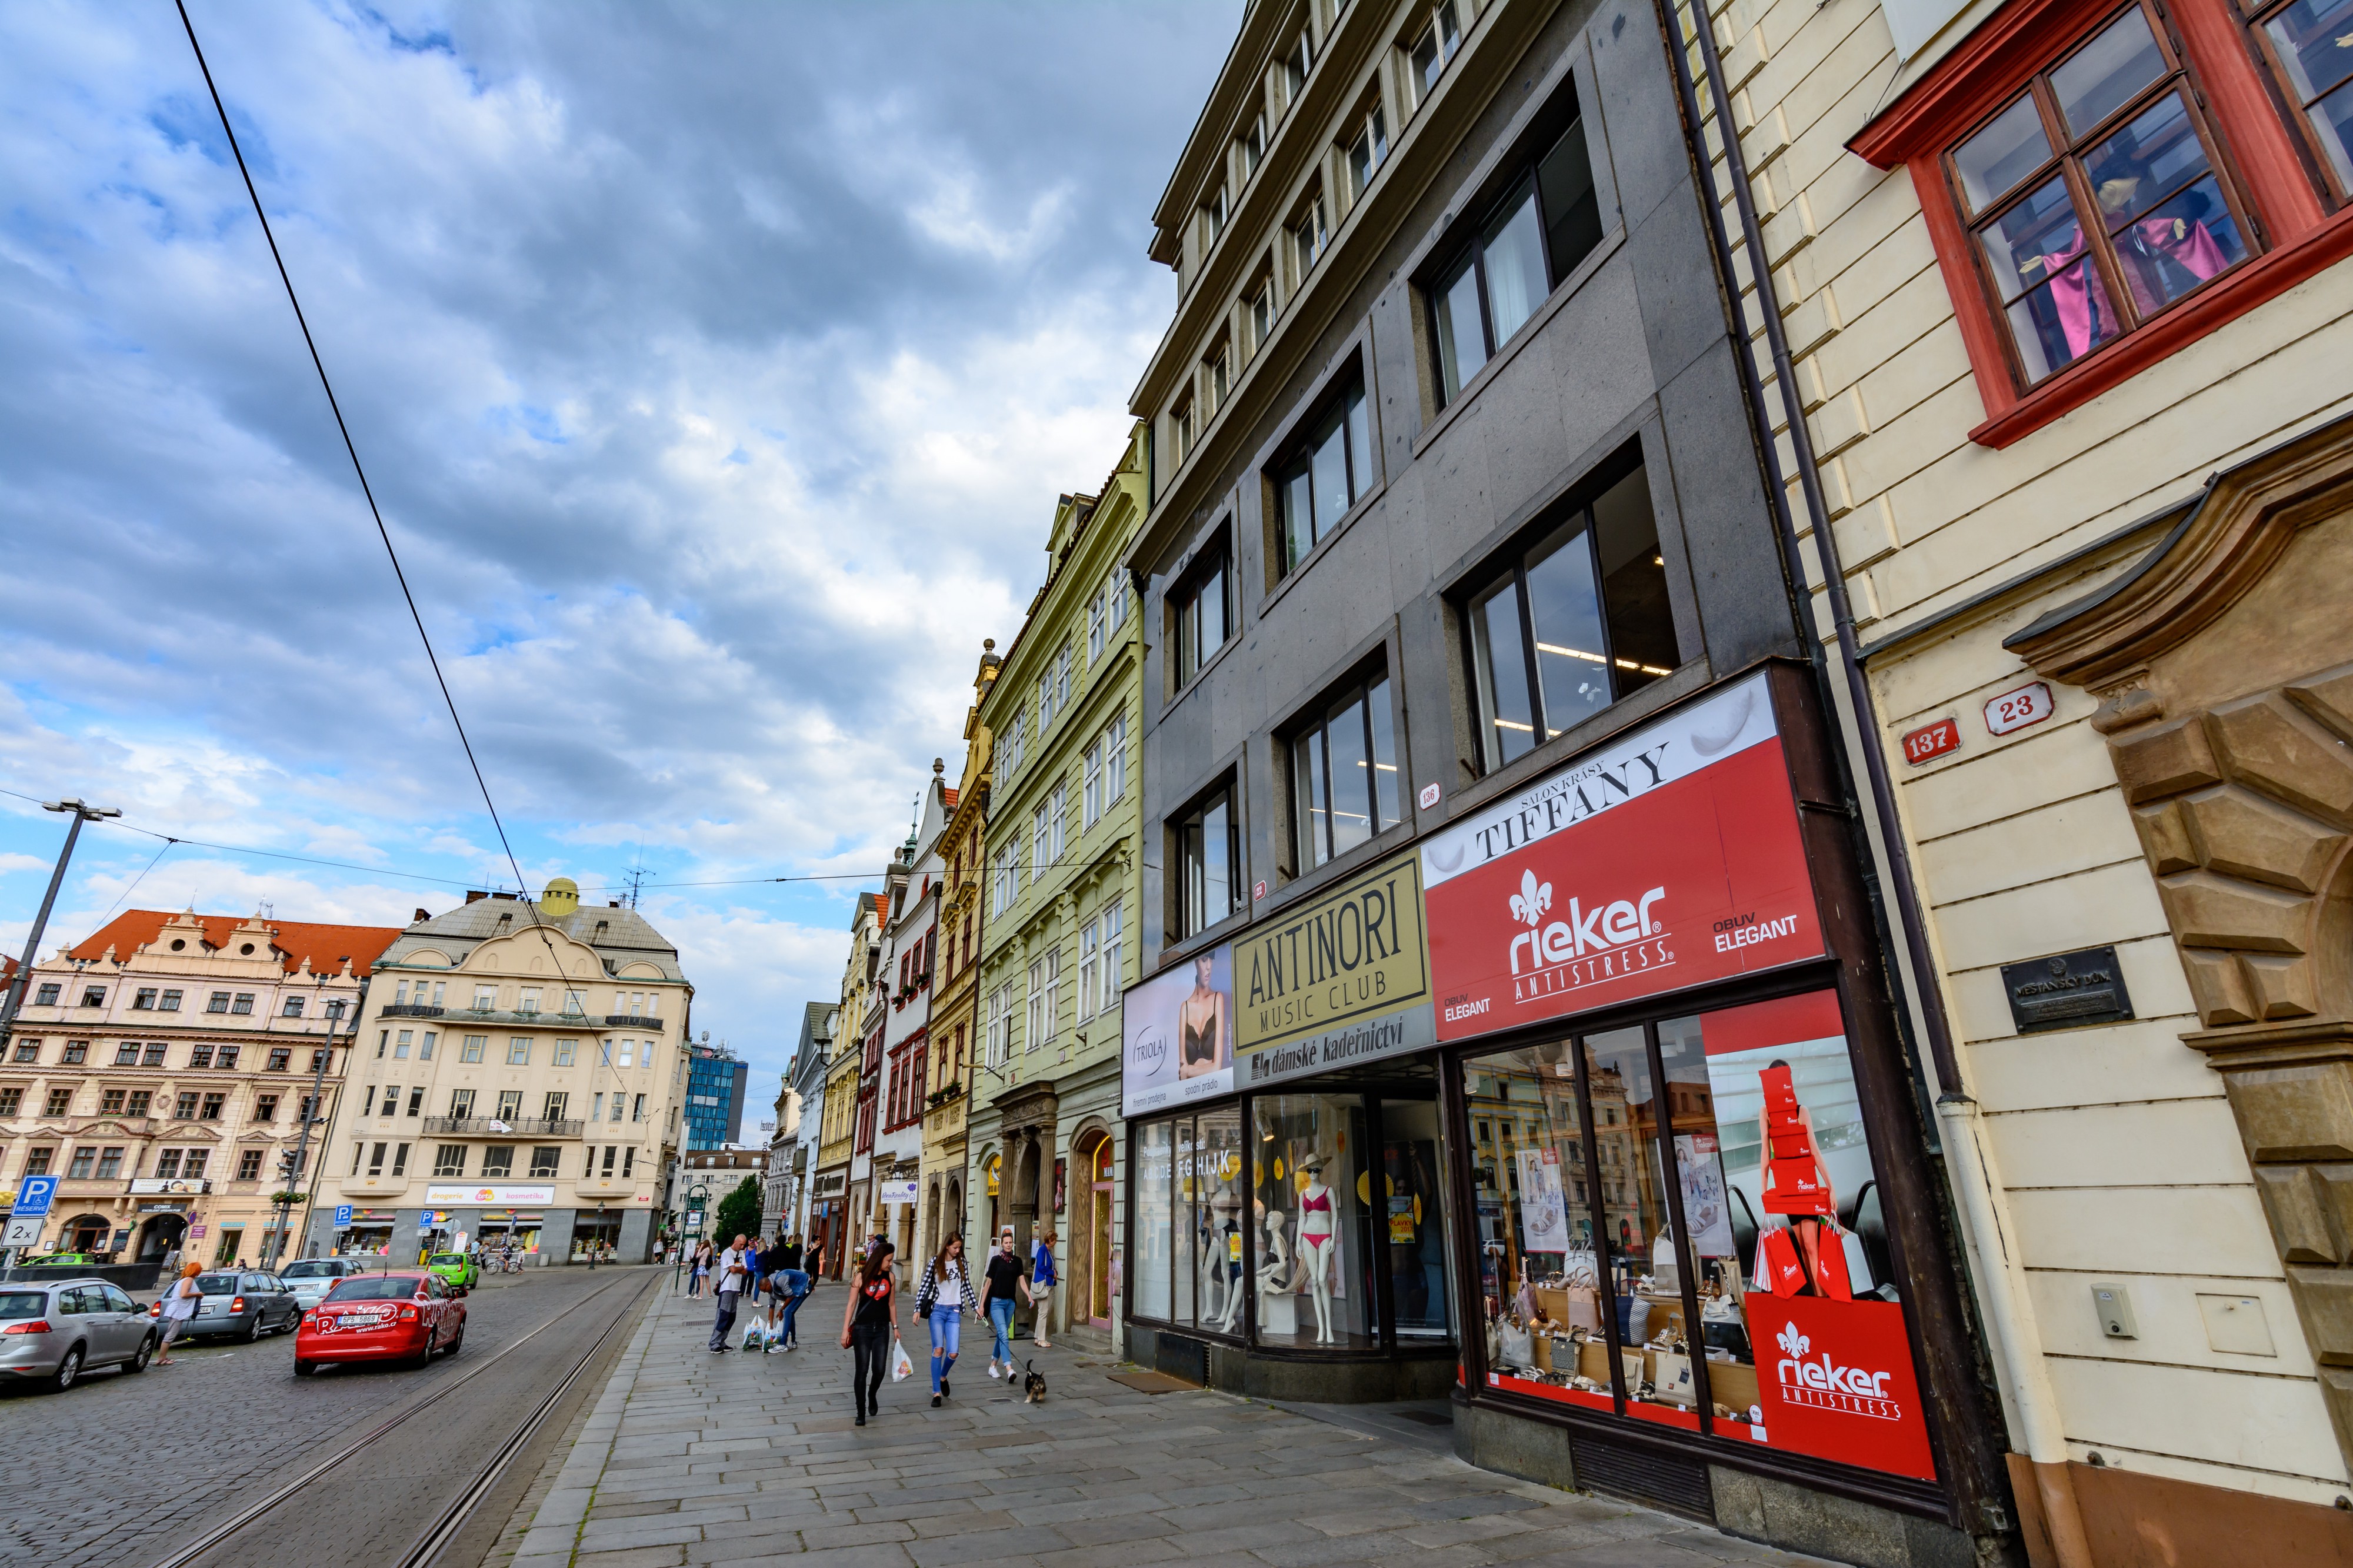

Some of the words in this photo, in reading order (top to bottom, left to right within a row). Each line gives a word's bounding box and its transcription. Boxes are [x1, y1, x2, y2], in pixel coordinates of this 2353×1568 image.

[1999, 695, 2034, 723] 23
[1909, 726, 1947, 758] 137
[1423, 789, 1435, 804] 136
[1521, 783, 1559, 809] SALON
[1561, 760, 1605, 789] KRÁSY
[1476, 742, 1670, 862] TIFFANY
[1256, 885, 1262, 896] 22
[1509, 886, 1665, 975] rieker
[1713, 912, 1755, 933] OBUV
[1715, 915, 1797, 953] ELEGANT
[1248, 879, 1401, 1008] ANTINORI
[1515, 941, 1667, 999] ANTISTRESS
[1260, 995, 1314, 1033] MUSIC
[1329, 970, 1386, 1010] CLUB
[1444, 993, 1468, 1007] OBUV
[1445, 997, 1491, 1022] ELEGANT
[1136, 1039, 1163, 1062] TRIOLA
[1272, 1040, 1317, 1074] dámské
[1323, 1016, 1403, 1062] kadeřnictví
[1133, 1095, 1147, 1107] firemní
[1148, 1092, 1166, 1106] prodejna
[1185, 1080, 1201, 1096] spodní
[1202, 1078, 1218, 1093] prádlo
[24, 1180, 49, 1203] P
[1798, 1181, 1816, 1190] rieker
[338, 1207, 349, 1220] P
[422, 1212, 431, 1222] P
[356, 1322, 396, 1333] www.rako.cz
[1778, 1353, 1891, 1397] rieker
[1783, 1387, 1901, 1419] ANTISTRESS
